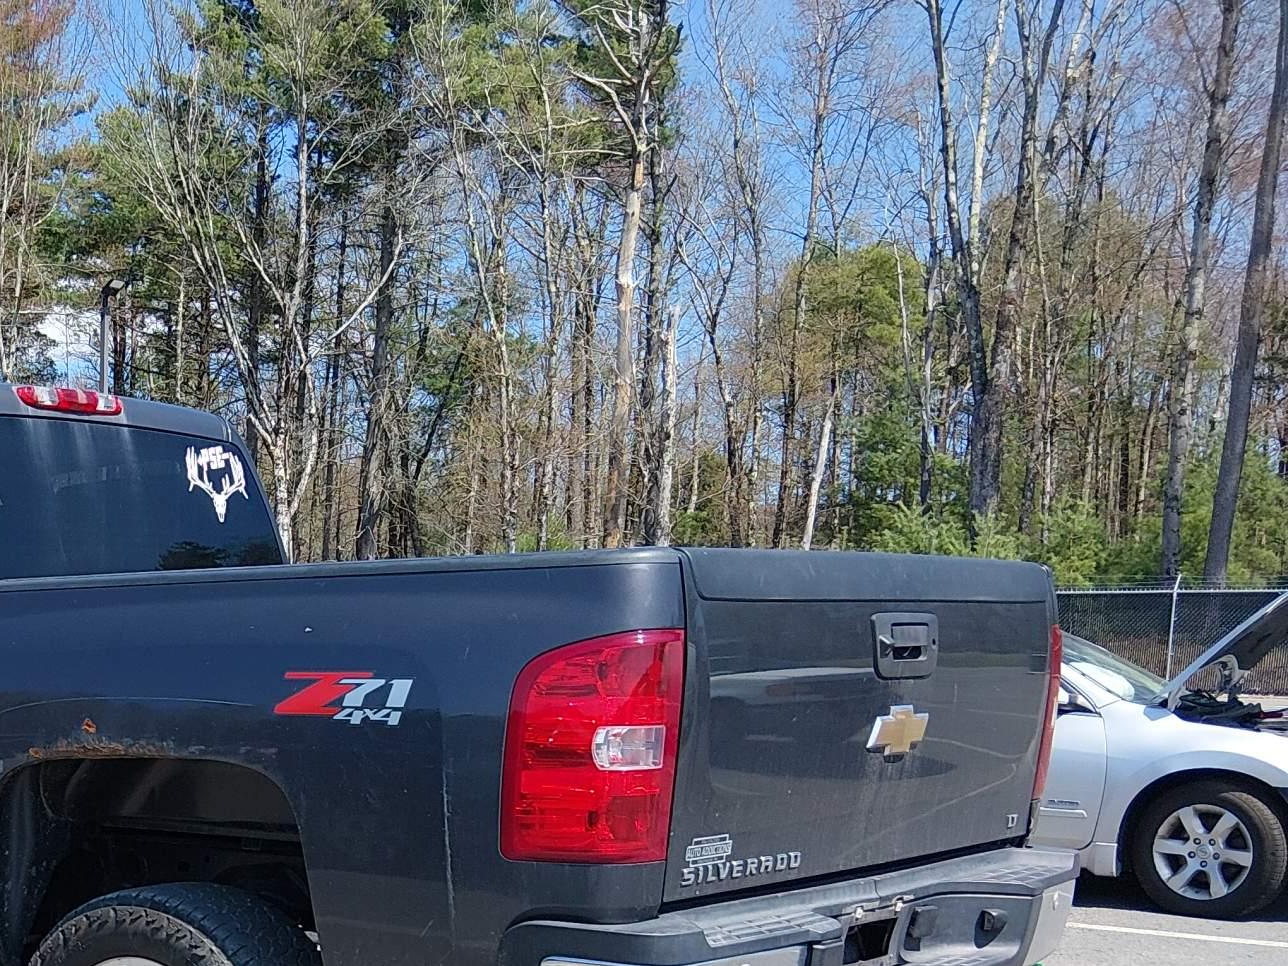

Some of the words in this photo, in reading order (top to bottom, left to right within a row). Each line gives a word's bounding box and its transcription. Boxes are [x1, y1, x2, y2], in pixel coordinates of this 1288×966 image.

[273, 671, 414, 716] Z71
[681, 852, 801, 886] SILVERADO
[686, 847, 702, 858] AUTO
